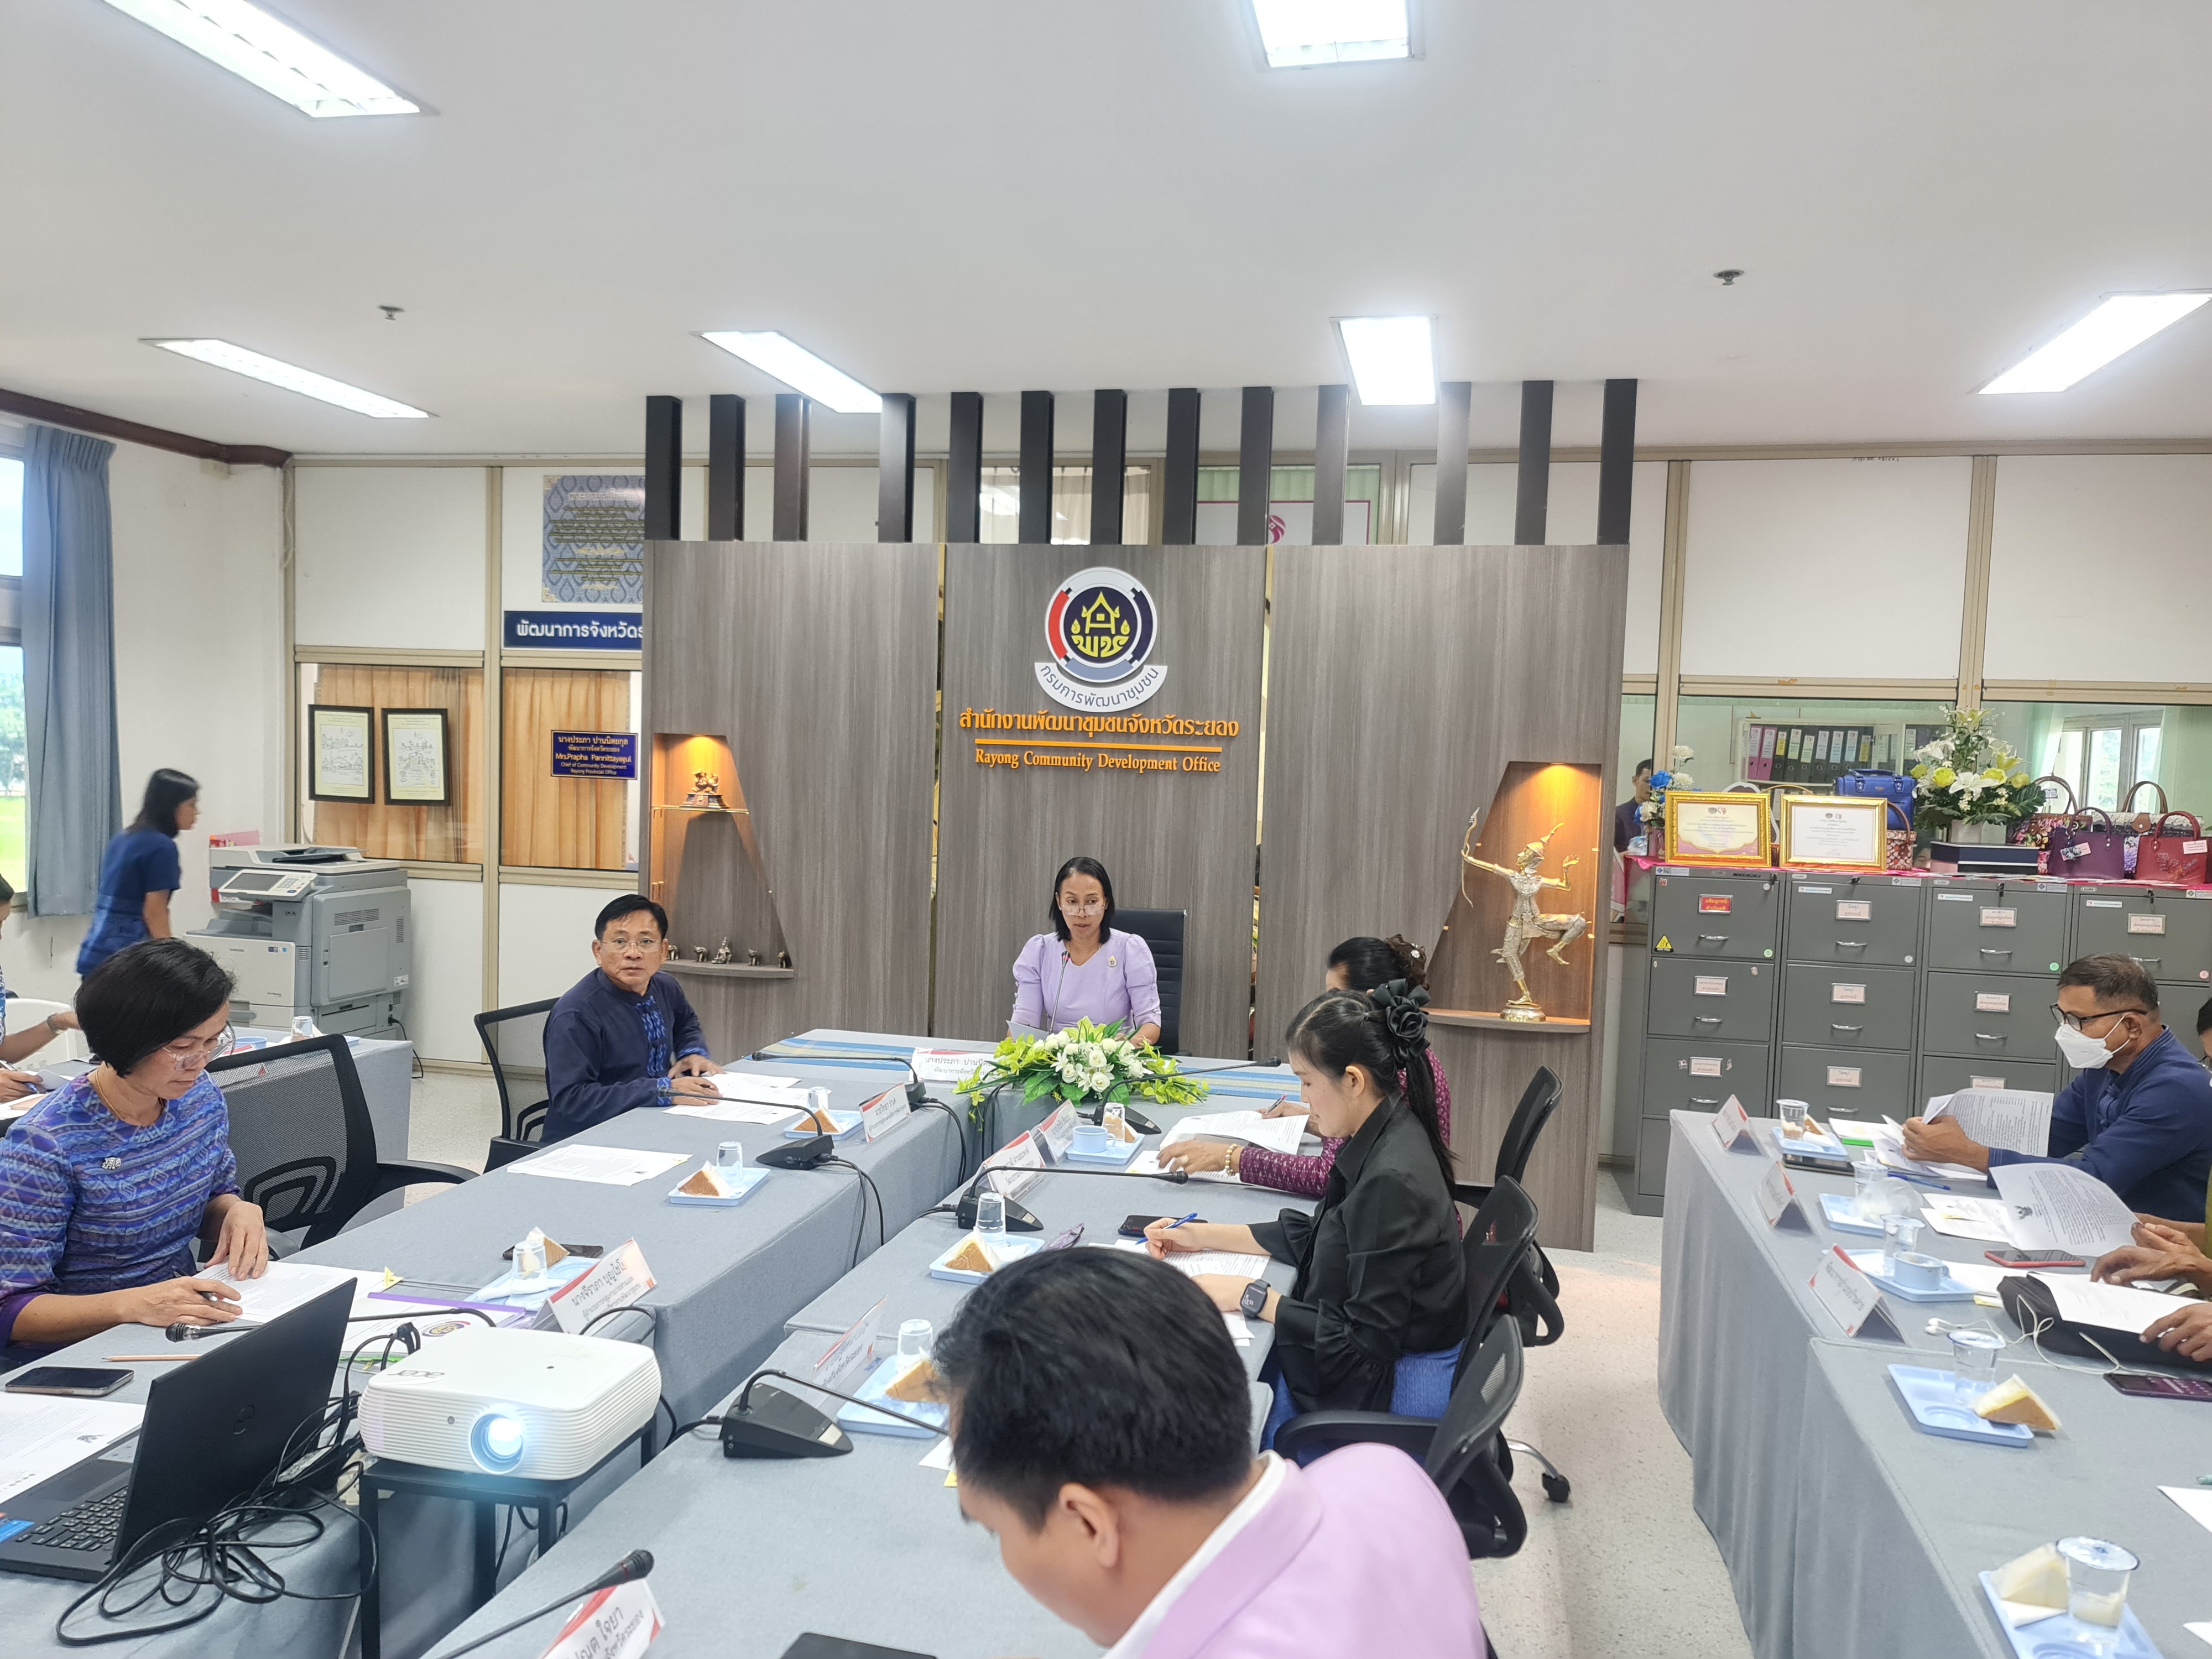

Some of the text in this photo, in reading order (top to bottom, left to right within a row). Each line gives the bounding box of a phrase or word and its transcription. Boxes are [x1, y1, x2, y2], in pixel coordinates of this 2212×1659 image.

[1040, 665, 1159, 707] กรมการพัฒนาชุมชน
[959, 708, 1239, 738] สำนักงานพัฒนาชุมชนจังหวัดระยอง
[559, 735, 591, 744] นางประภา
[975, 748, 1220, 774] Rayong Community Development Office
[572, 1279, 604, 1307] นางจีราภา
[387, 1370, 445, 1378] acer
